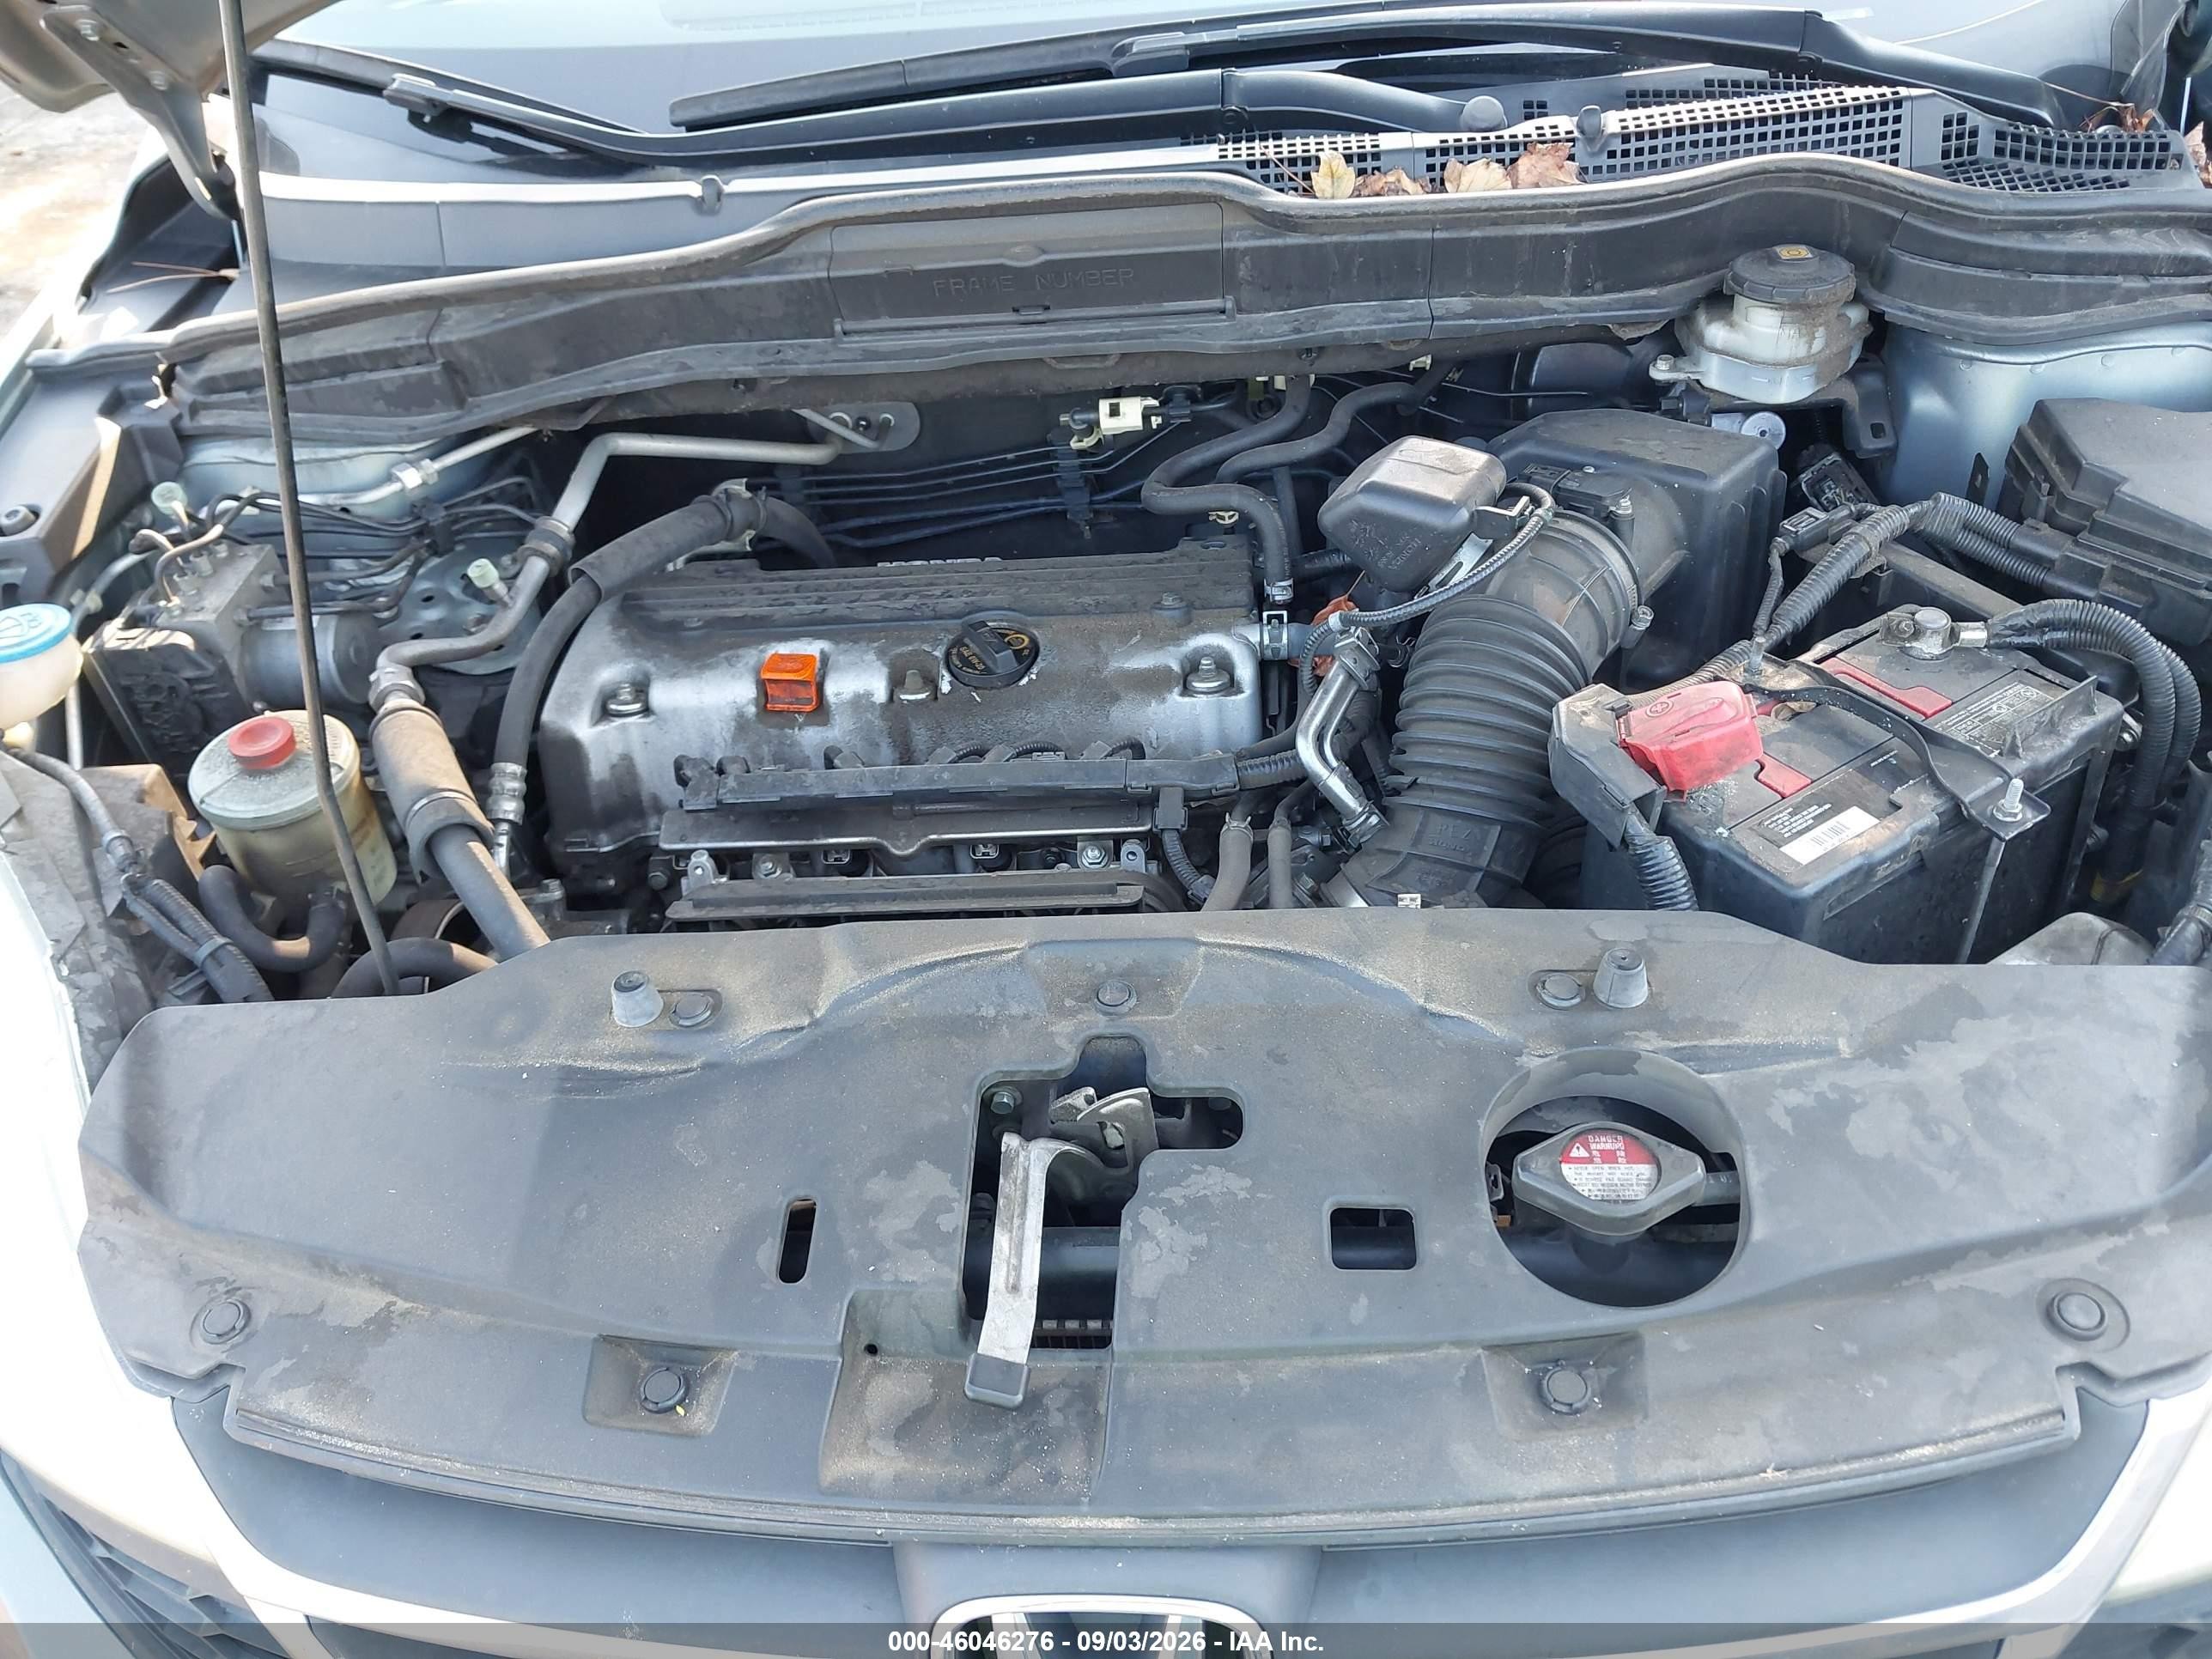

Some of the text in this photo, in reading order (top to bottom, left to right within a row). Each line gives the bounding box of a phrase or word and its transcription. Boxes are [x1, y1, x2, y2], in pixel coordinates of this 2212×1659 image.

[933, 267, 1134, 297] FRAME NUMBER
[1587, 1134, 1623, 1143] DANGER
